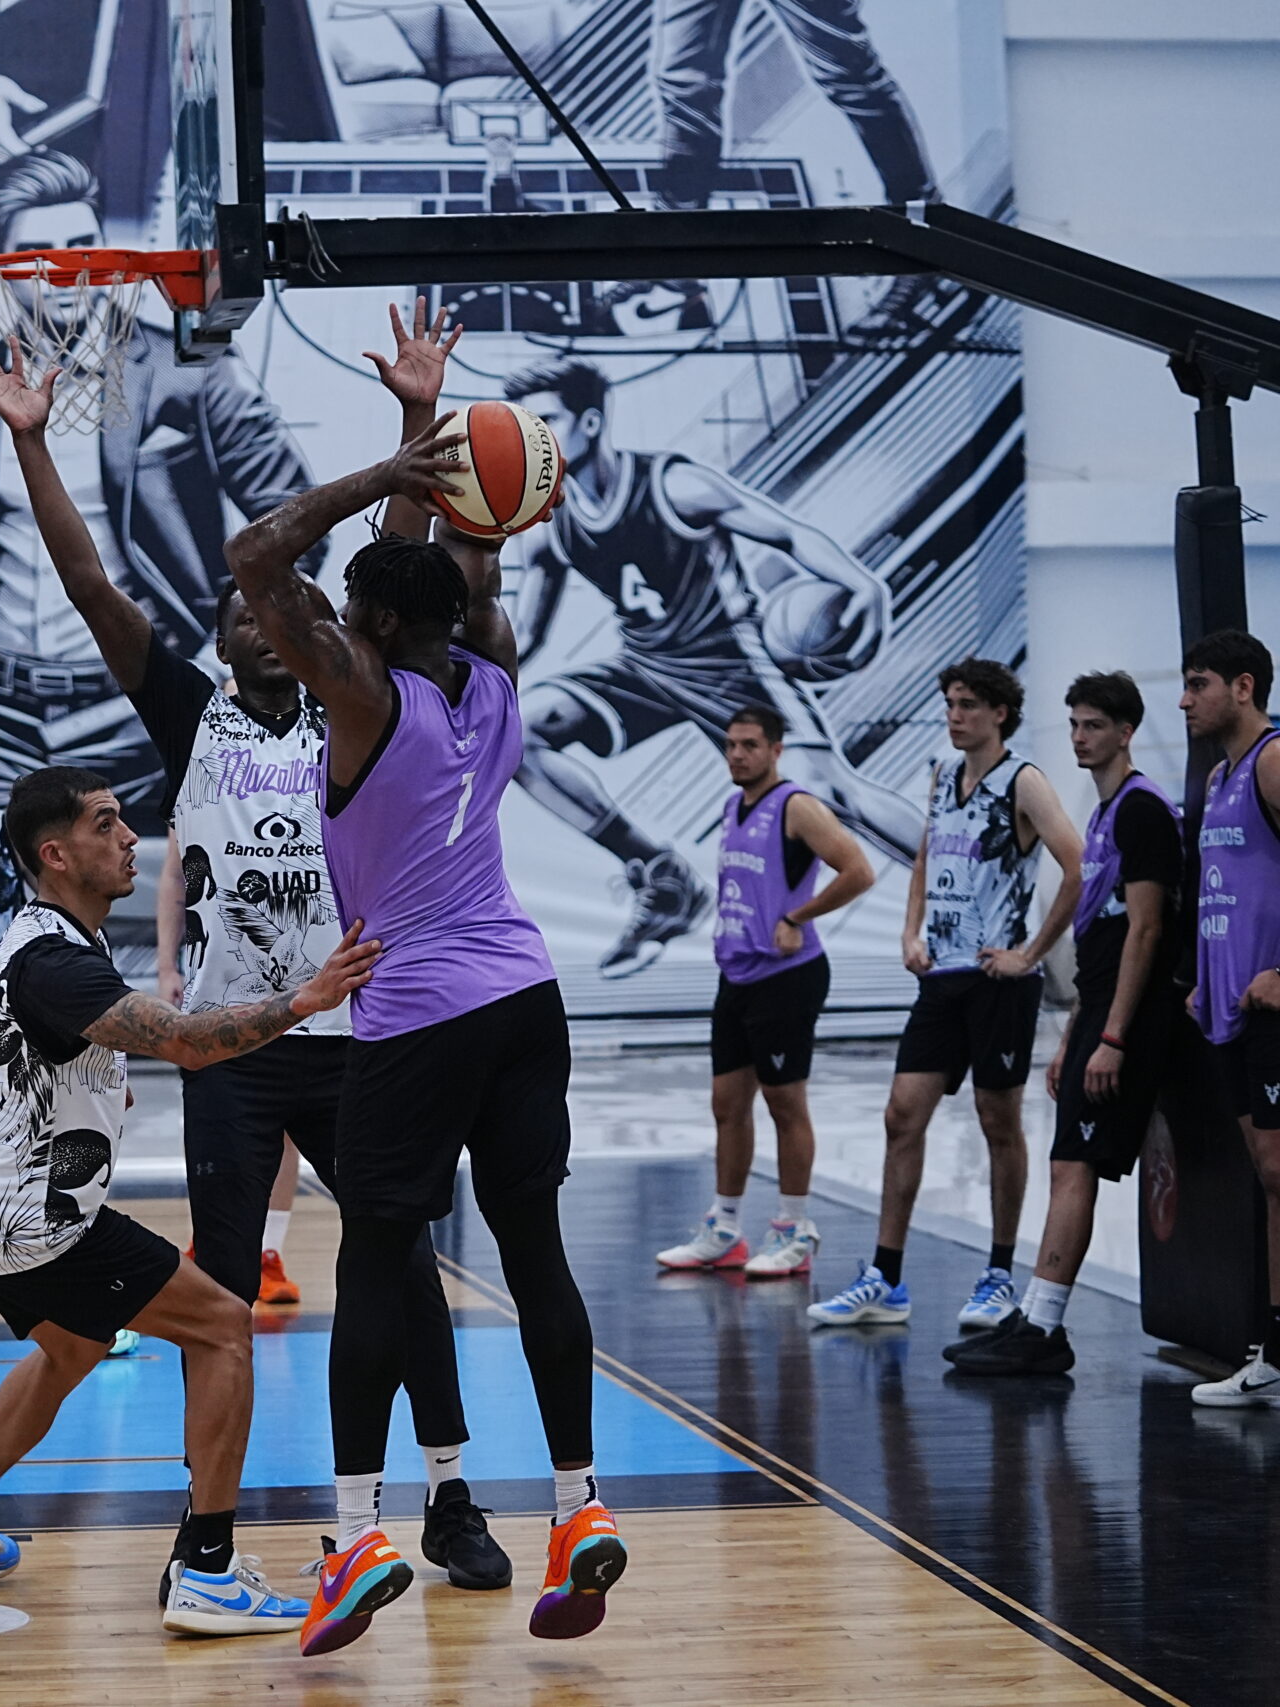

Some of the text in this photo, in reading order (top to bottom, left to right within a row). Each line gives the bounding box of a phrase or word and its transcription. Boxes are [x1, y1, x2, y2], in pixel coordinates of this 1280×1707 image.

[536, 420, 553, 494] SPALDIN
[621, 562, 668, 621] 4
[213, 723, 251, 741] Comex
[225, 842, 323, 858] Banco Aztec
[272, 870, 321, 894] UAD
